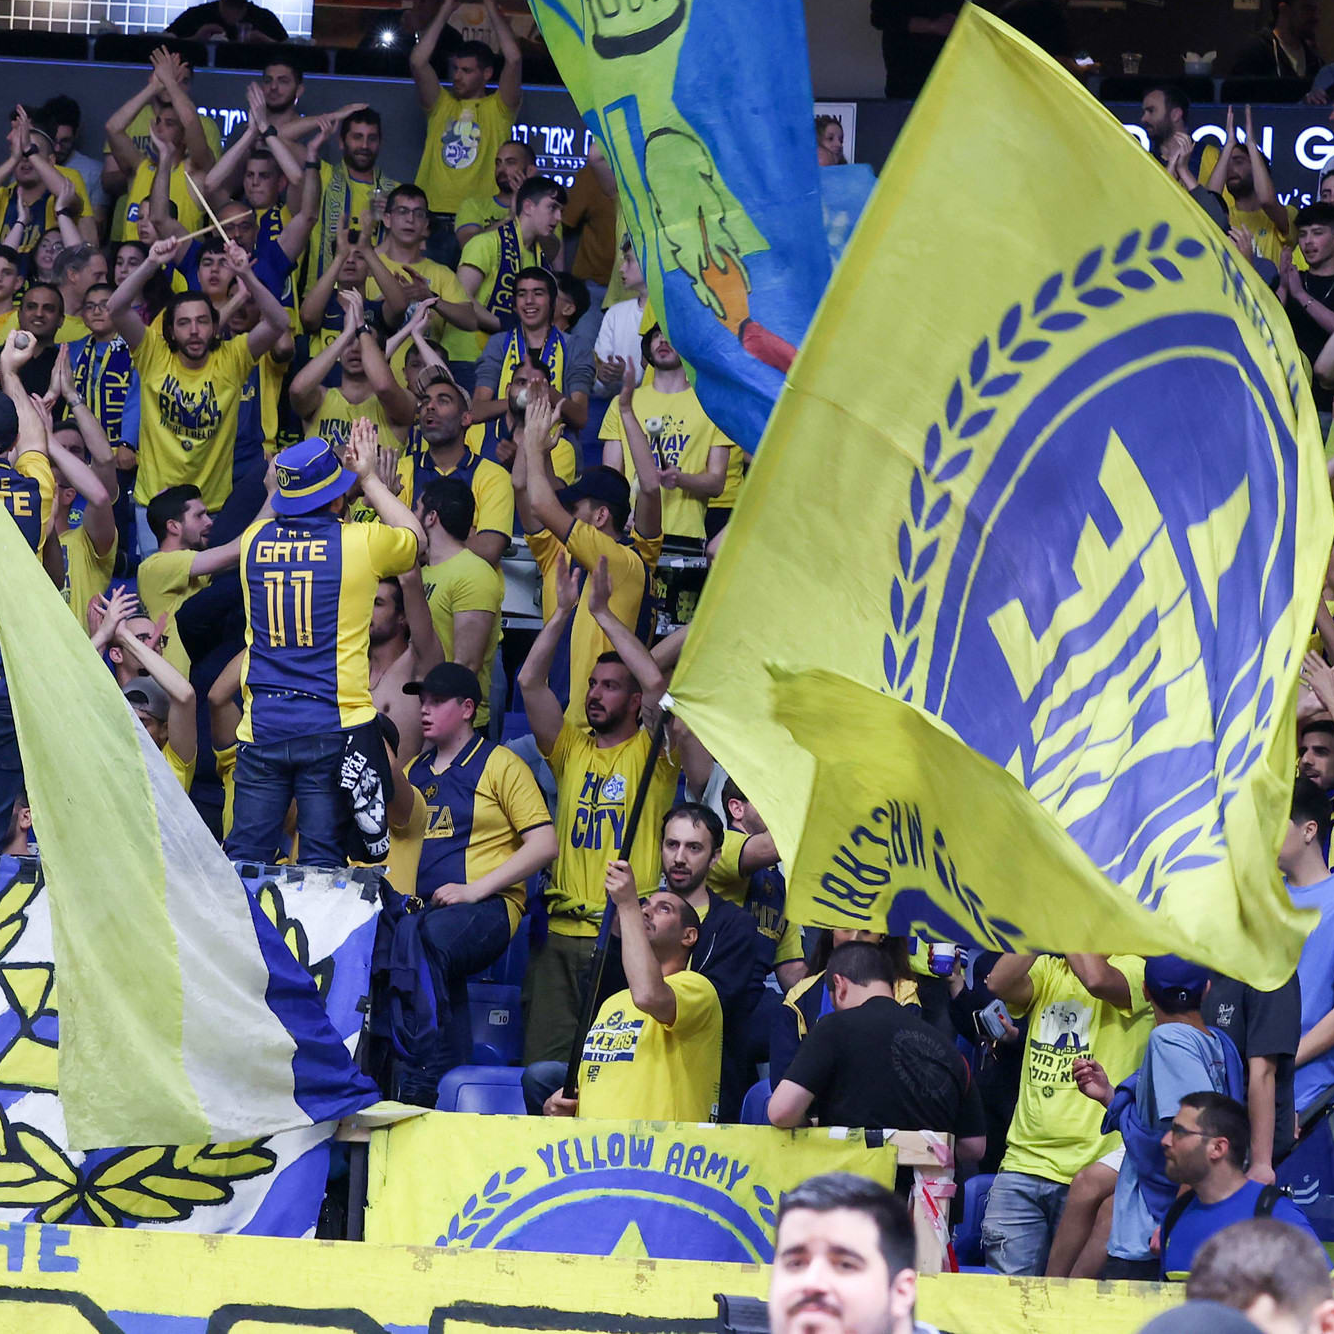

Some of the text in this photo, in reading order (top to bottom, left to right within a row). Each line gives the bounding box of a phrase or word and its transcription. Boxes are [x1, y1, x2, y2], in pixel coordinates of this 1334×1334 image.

[255, 540, 328, 564] GATE
[275, 527, 312, 539] THE
[262, 570, 314, 648] 11
[571, 808, 627, 852] CITY
[537, 1131, 750, 1191] YELLOW ARMY
